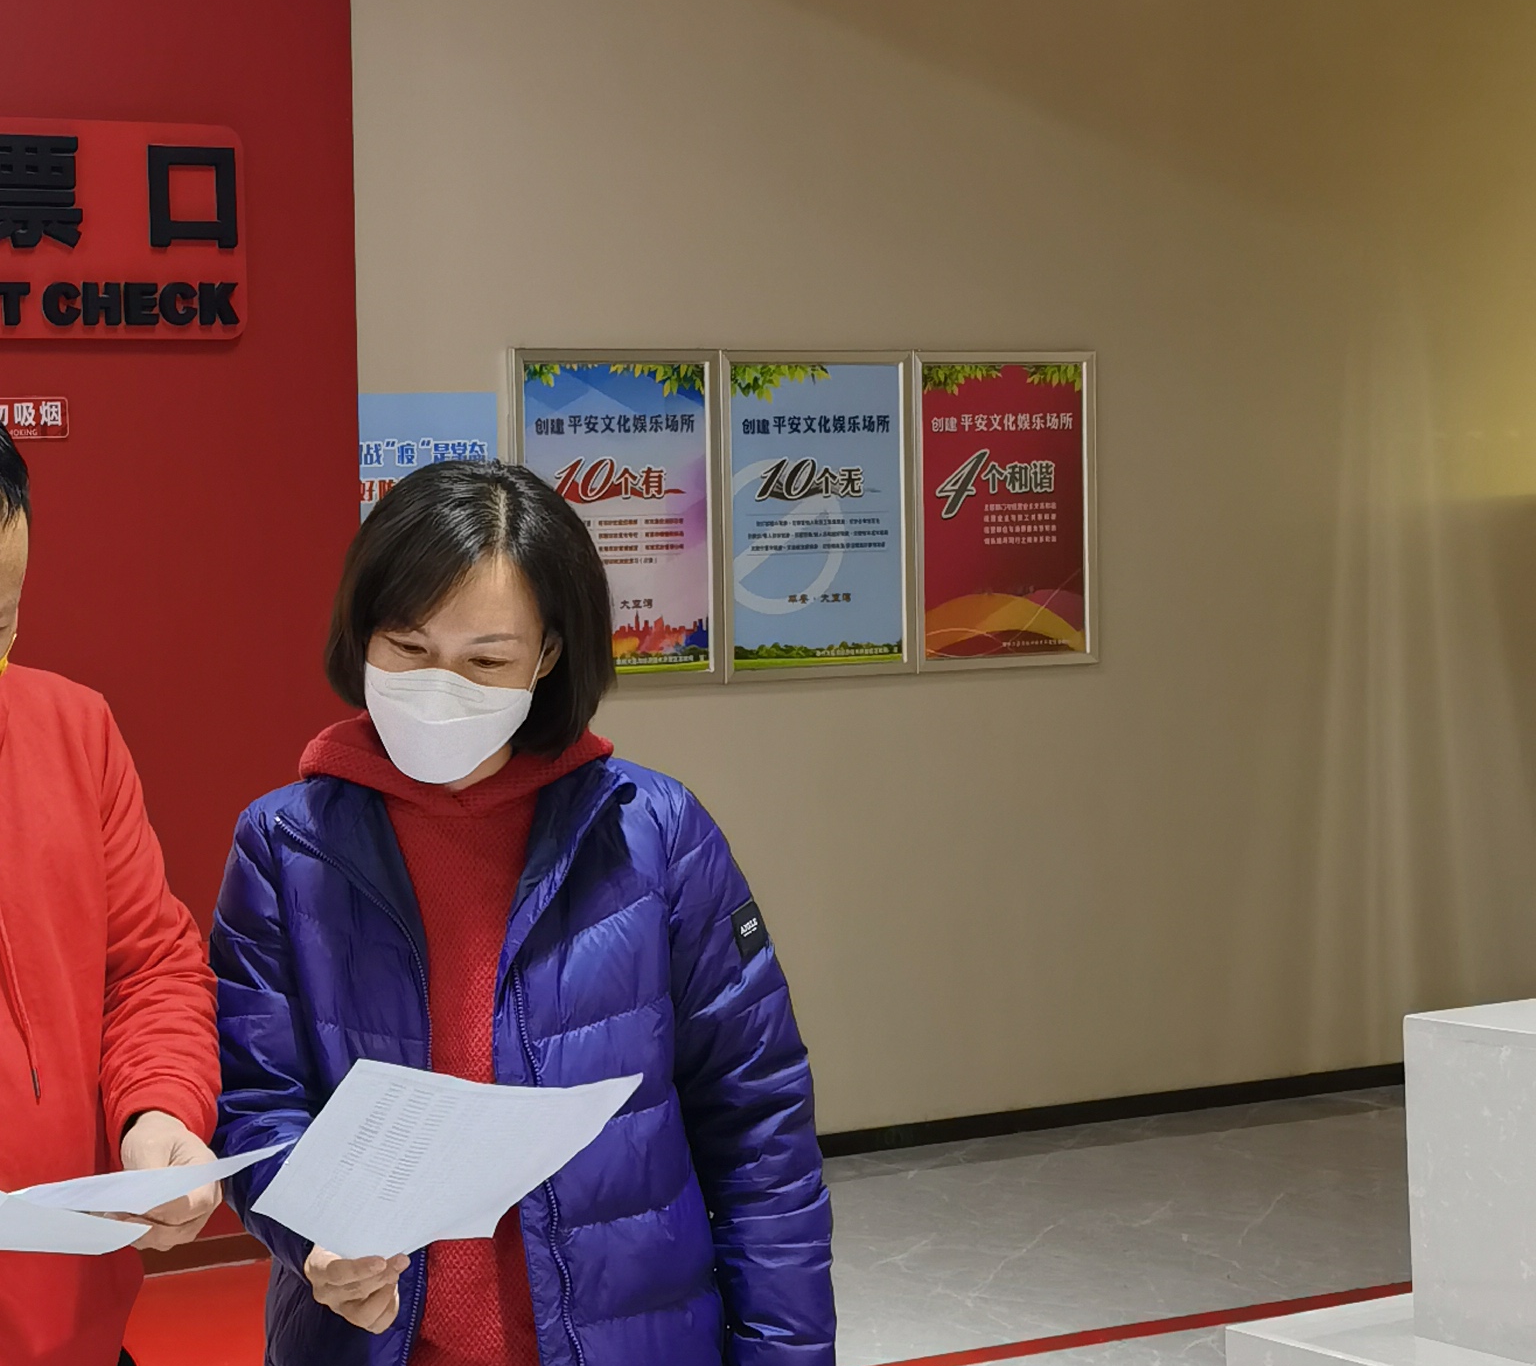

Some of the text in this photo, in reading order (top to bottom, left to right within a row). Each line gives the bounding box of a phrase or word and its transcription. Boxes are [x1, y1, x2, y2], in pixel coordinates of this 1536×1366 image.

[41, 281, 240, 327] CHECK
[754, 455, 865, 502] 10个无
[935, 448, 1056, 520] 4个和谐
